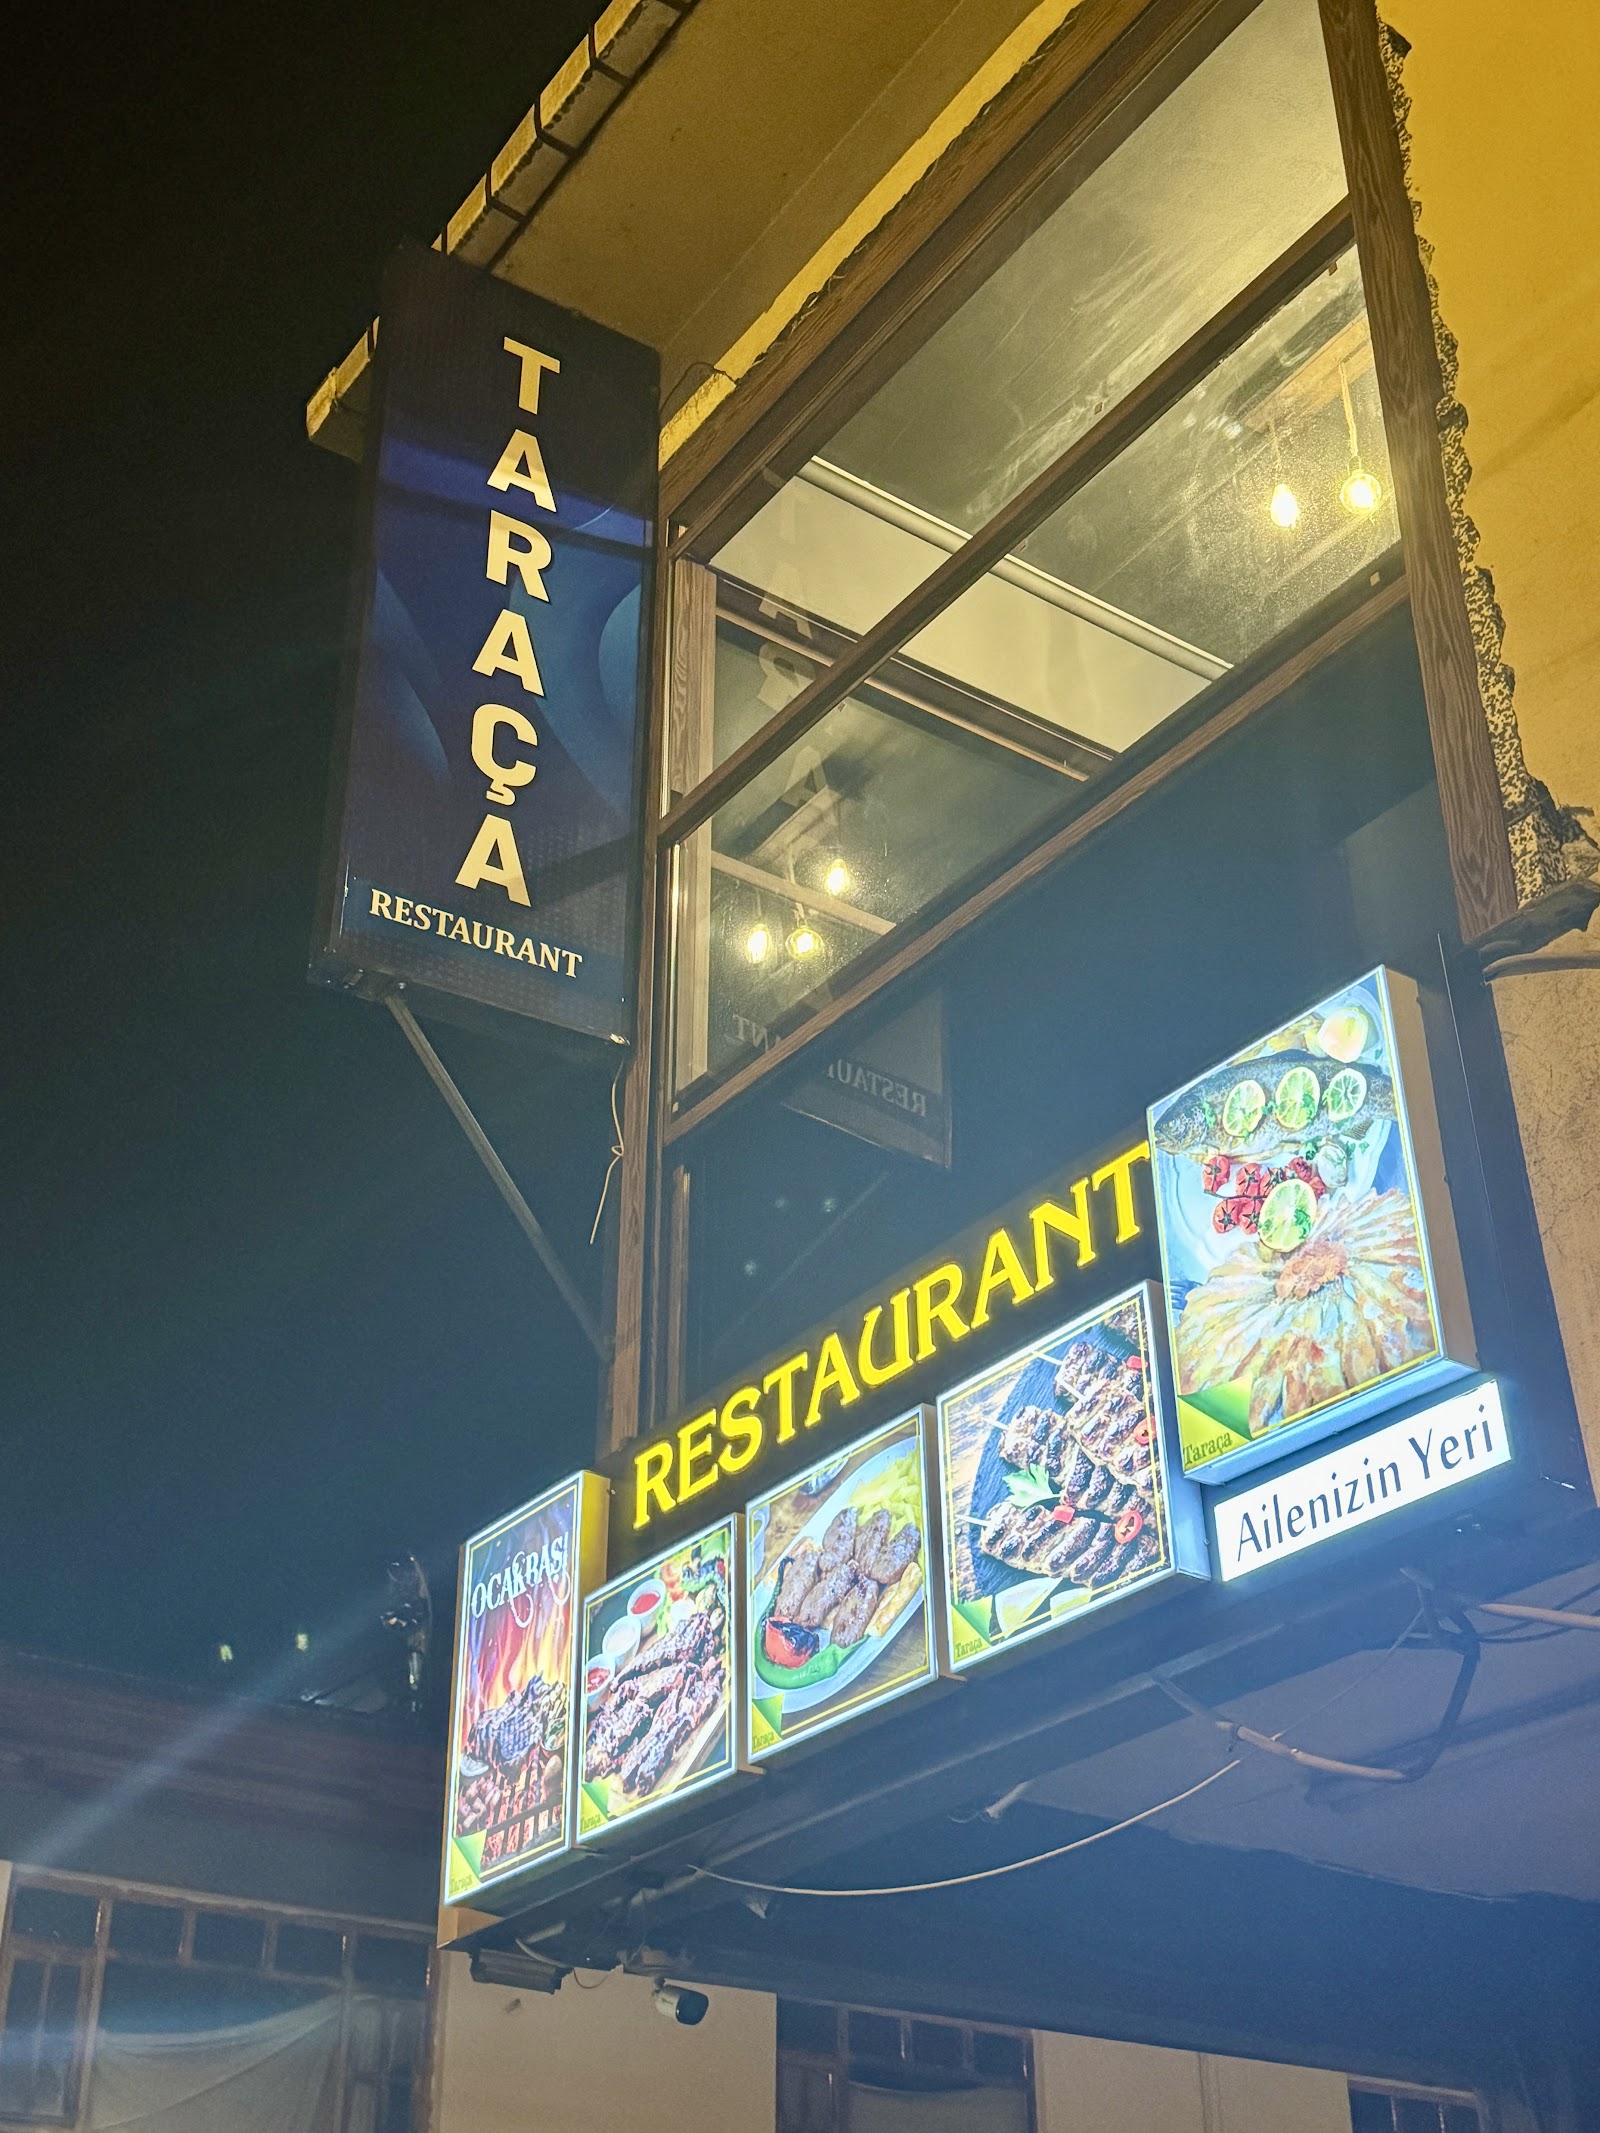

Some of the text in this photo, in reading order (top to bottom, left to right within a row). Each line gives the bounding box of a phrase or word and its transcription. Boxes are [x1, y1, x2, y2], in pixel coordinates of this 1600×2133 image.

[455, 337, 561, 907] TARAÇA
[369, 888, 583, 980] RESTAURANT
[633, 1140, 1151, 1530] RESTAURANT
[1183, 1432, 1233, 1466] Taraça
[1236, 1403, 1493, 1563] Ailenizin Yeri
[955, 1637, 983, 1659] Taraça
